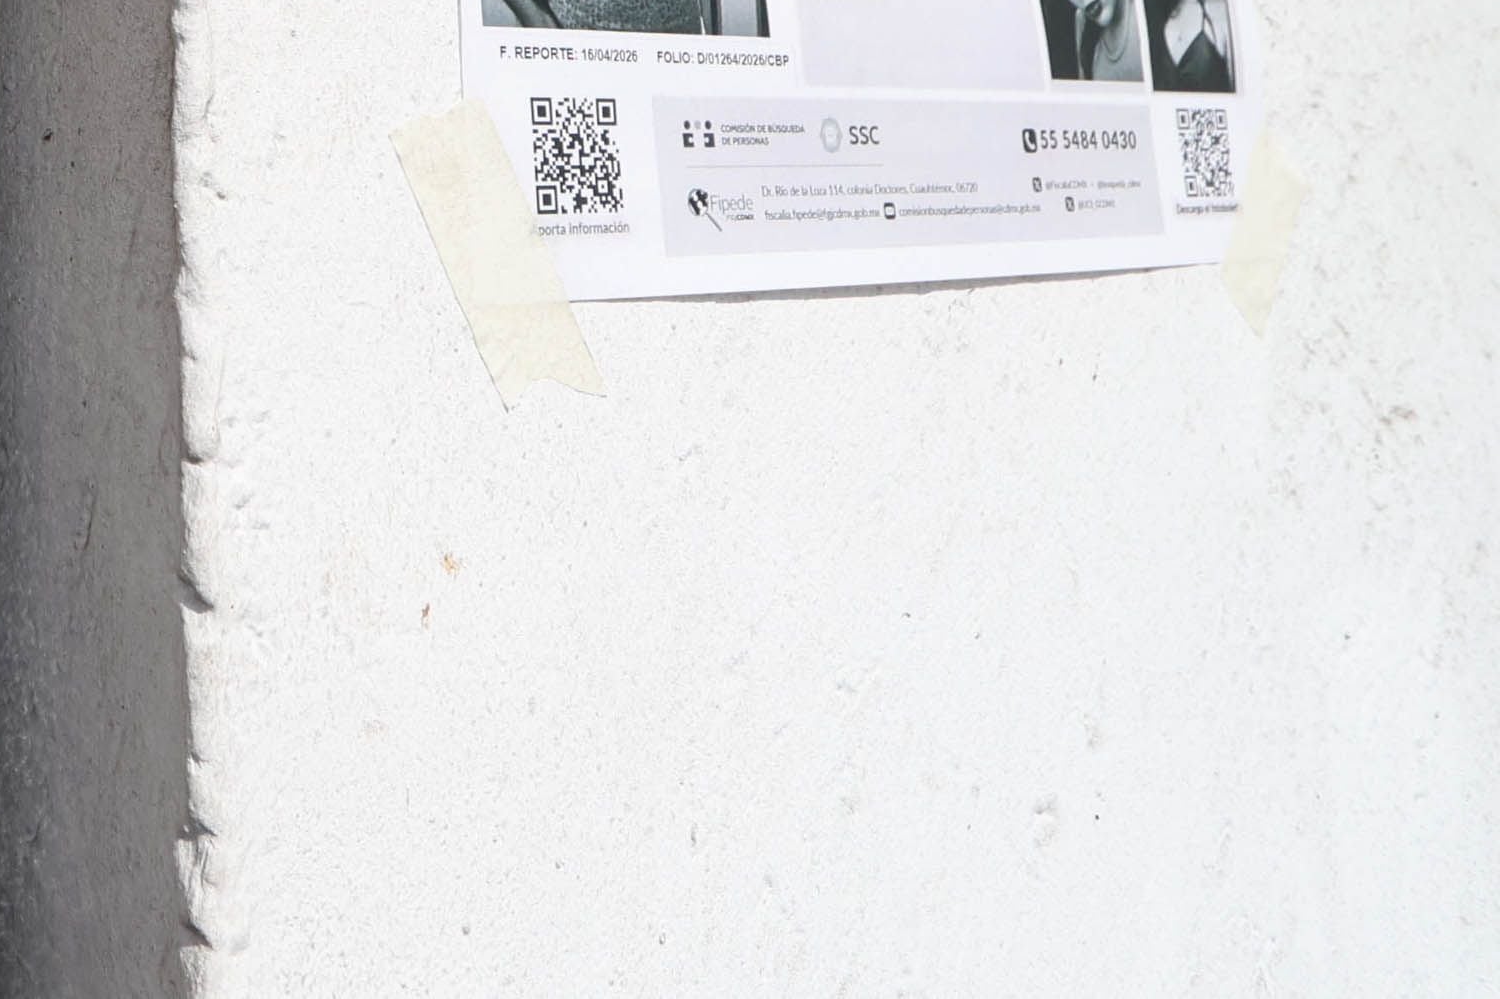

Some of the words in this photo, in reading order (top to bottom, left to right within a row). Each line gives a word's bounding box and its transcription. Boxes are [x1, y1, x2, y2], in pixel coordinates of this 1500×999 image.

[499, 46, 511, 59] F.
[515, 46, 578, 61] REPORTE:
[581, 48, 638, 63] 16/04/2026
[657, 50, 695, 64] FOLIO:
[697, 52, 790, 67] D/01264/2026/CBP
[720, 123, 756, 134] COMISIÓN
[757, 124, 766, 133] DE
[767, 123, 805, 134] BÚSQUEDA
[849, 126, 880, 145] SSC
[722, 137, 731, 145] DE
[732, 137, 770, 146] PERSONAS
[1040, 130, 1058, 149] 55
[1063, 130, 1098, 149] 5484
[1102, 130, 1137, 149] 0430
[710, 194, 754, 213] Fipede
[535, 224, 566, 237] porta
[569, 221, 630, 234] información
